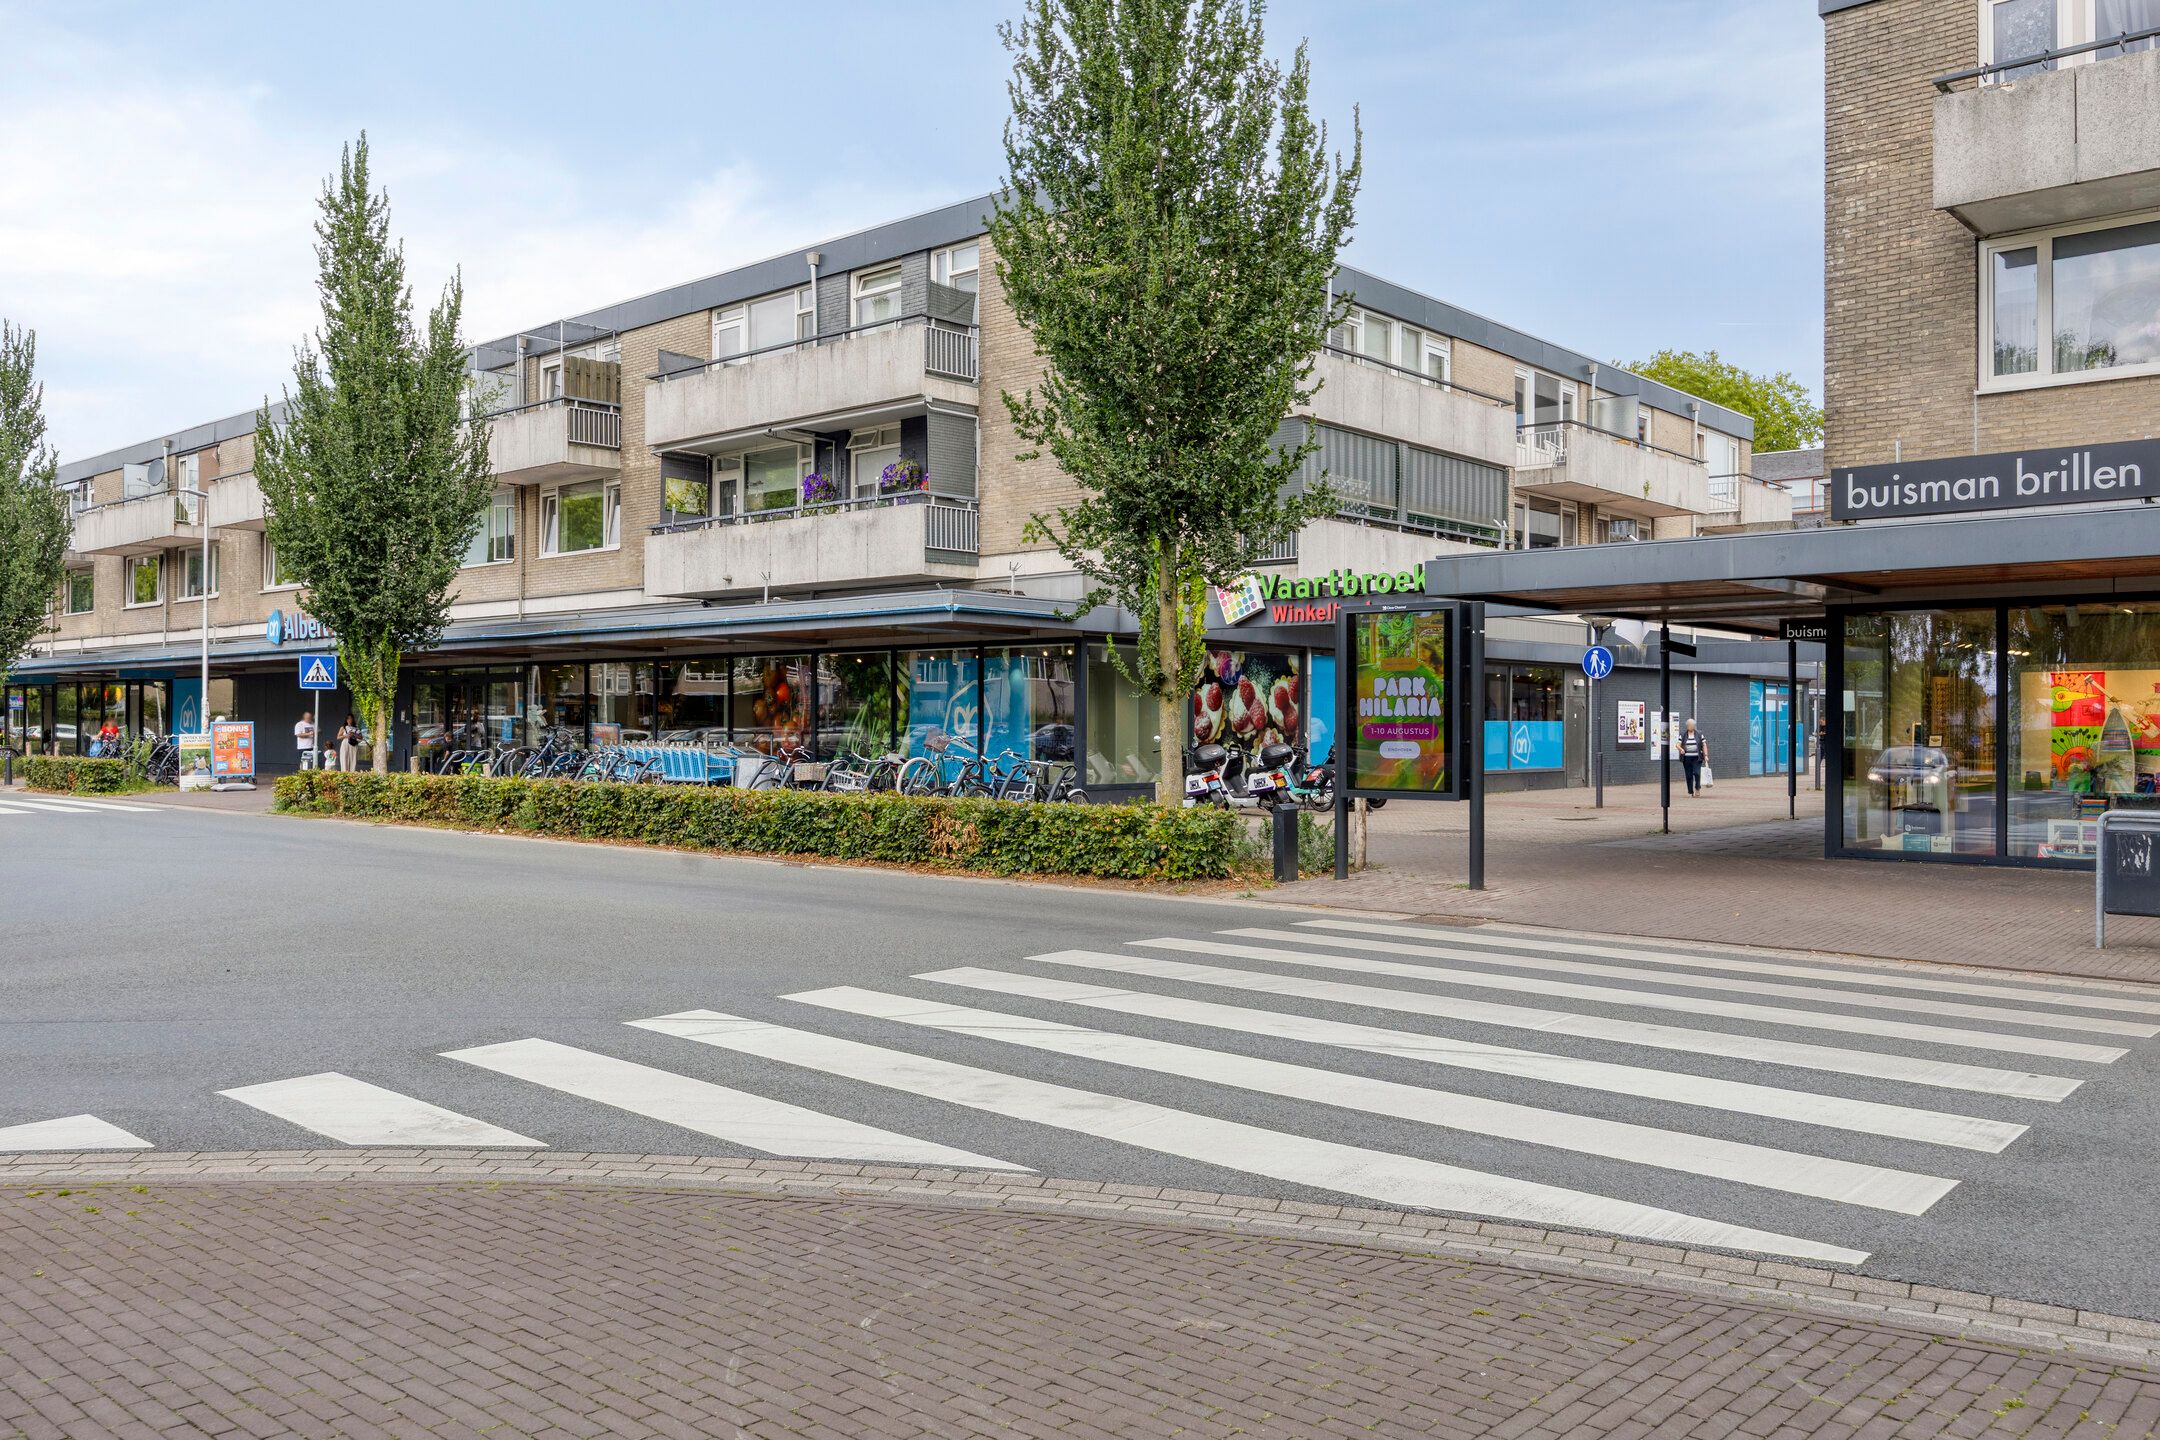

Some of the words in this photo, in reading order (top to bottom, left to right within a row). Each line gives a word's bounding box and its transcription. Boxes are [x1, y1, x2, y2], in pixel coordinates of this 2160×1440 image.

[1847, 473, 1999, 509] buisman
[2016, 451, 2142, 496] brillen
[1260, 563, 1426, 600] Vaartbroek
[1373, 676, 1426, 697] PARK
[1359, 696, 1442, 717] HILARIA
[221, 725, 249, 733] BONUS
[1370, 727, 1385, 735] 1-10
[1386, 727, 1430, 735] AUGUSTUS
